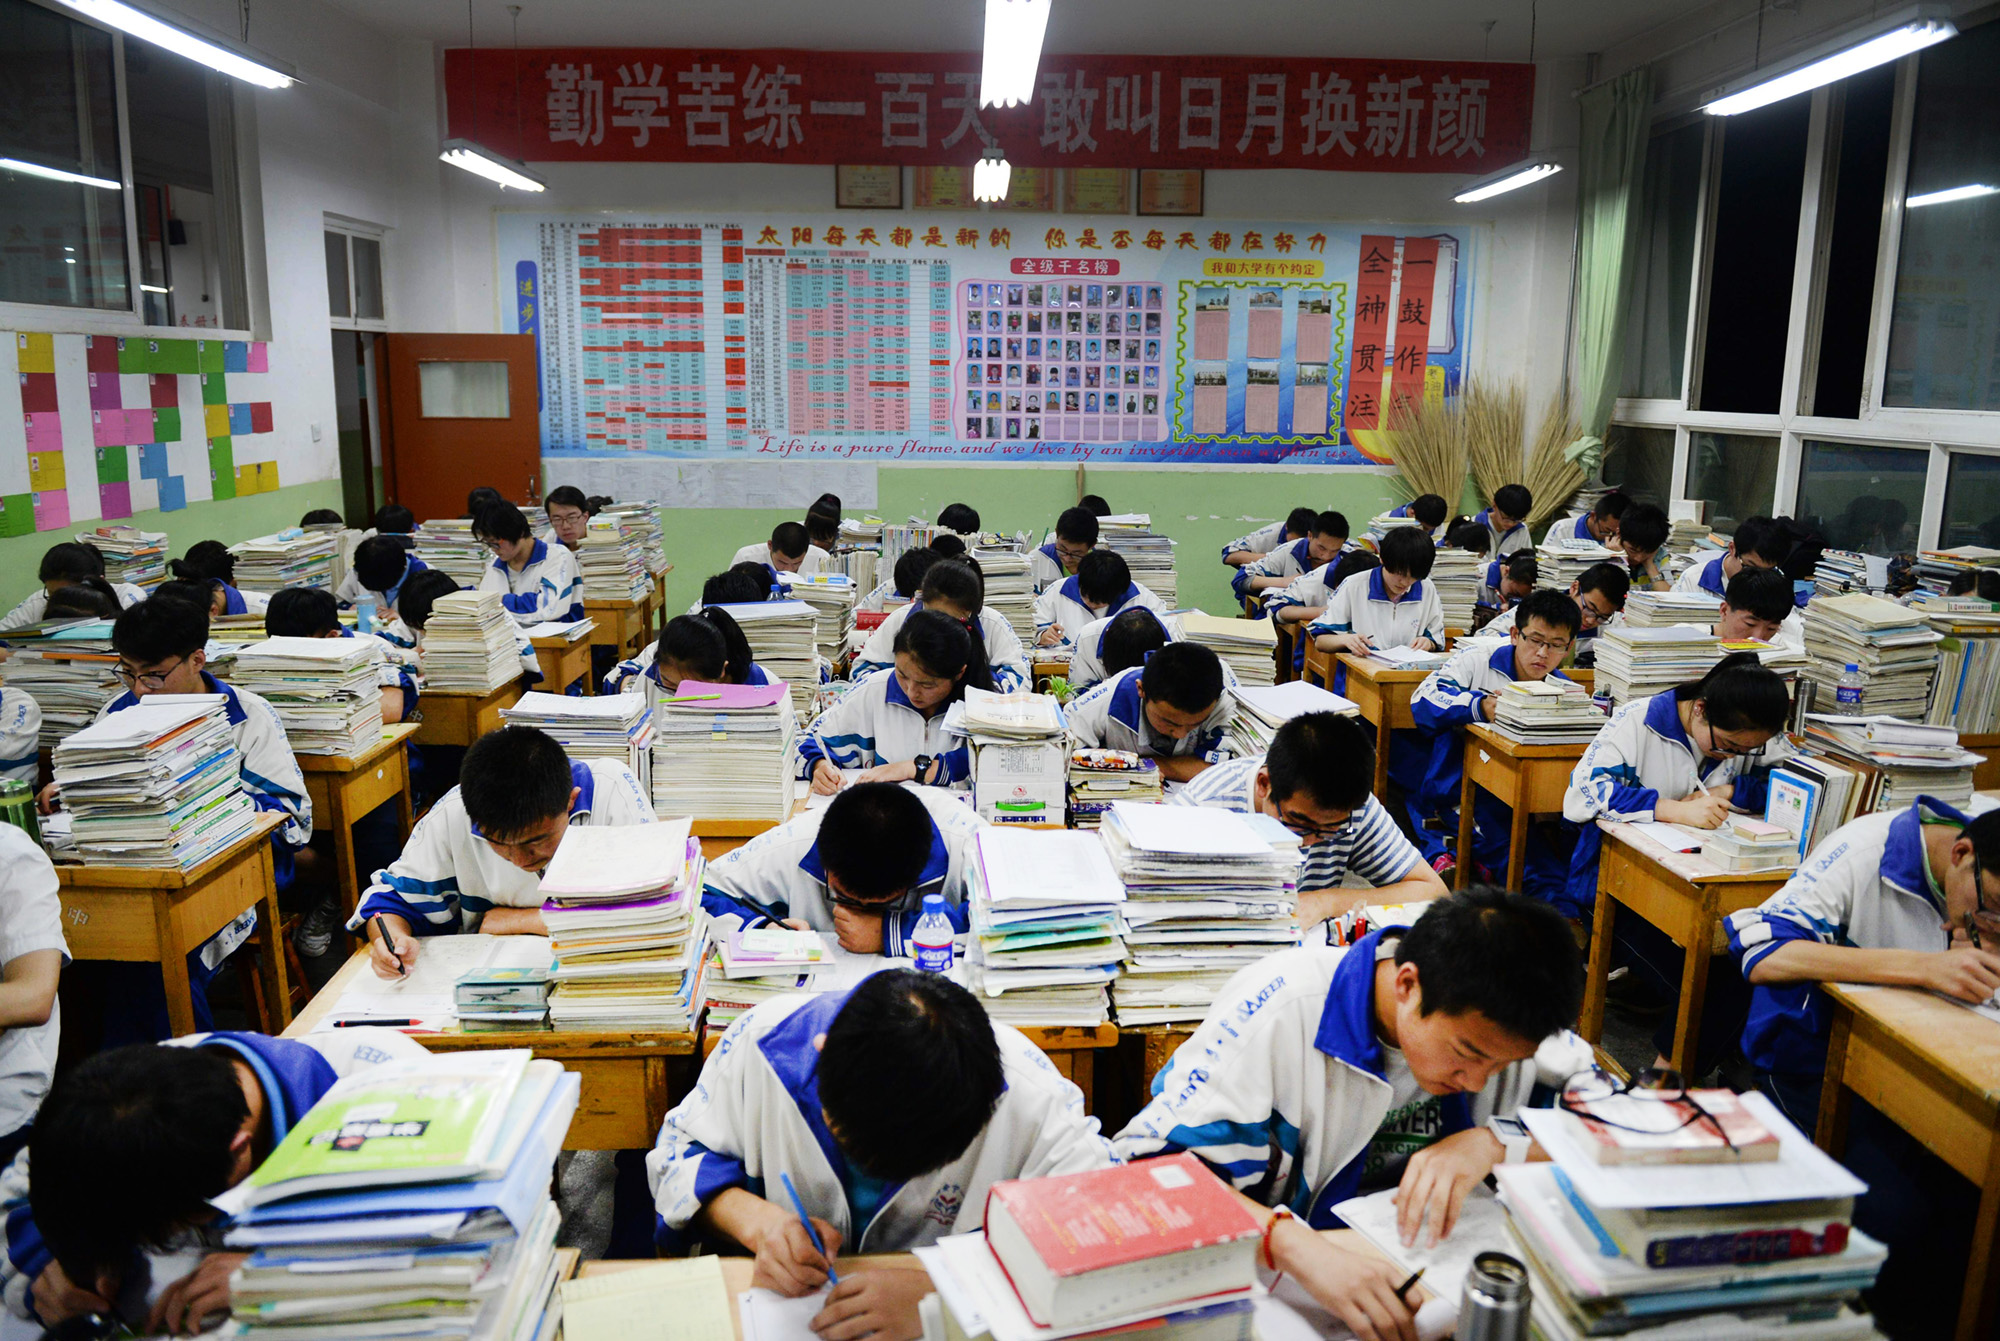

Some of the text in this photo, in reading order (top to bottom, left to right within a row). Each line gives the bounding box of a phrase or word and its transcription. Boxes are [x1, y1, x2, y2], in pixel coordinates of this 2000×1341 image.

[544, 62, 1490, 159] 勤学苦练一百天 敢叫日月换新颜
[756, 225, 1328, 252] 太阳每天都是新的 你是否每天都在努力
[1021, 258, 1110, 275] 全级千名榜
[1211, 262, 1316, 276] 我和大学有个约定
[1350, 246, 1391, 417] 全神贯注
[756, 435, 805, 458] Life
[809, 441, 827, 452] is
[833, 444, 843, 453] a
[843, 443, 894, 458] pure
[960, 441, 1001, 454] and
[1002, 445, 1025, 454] we
[1029, 441, 1066, 455] live
[1070, 442, 1094, 461] by
[1100, 446, 1123, 455] an
[1129, 443, 1212, 456] invisible
[1258, 445, 1319, 458] within
[68, 907, 89, 926] 中
